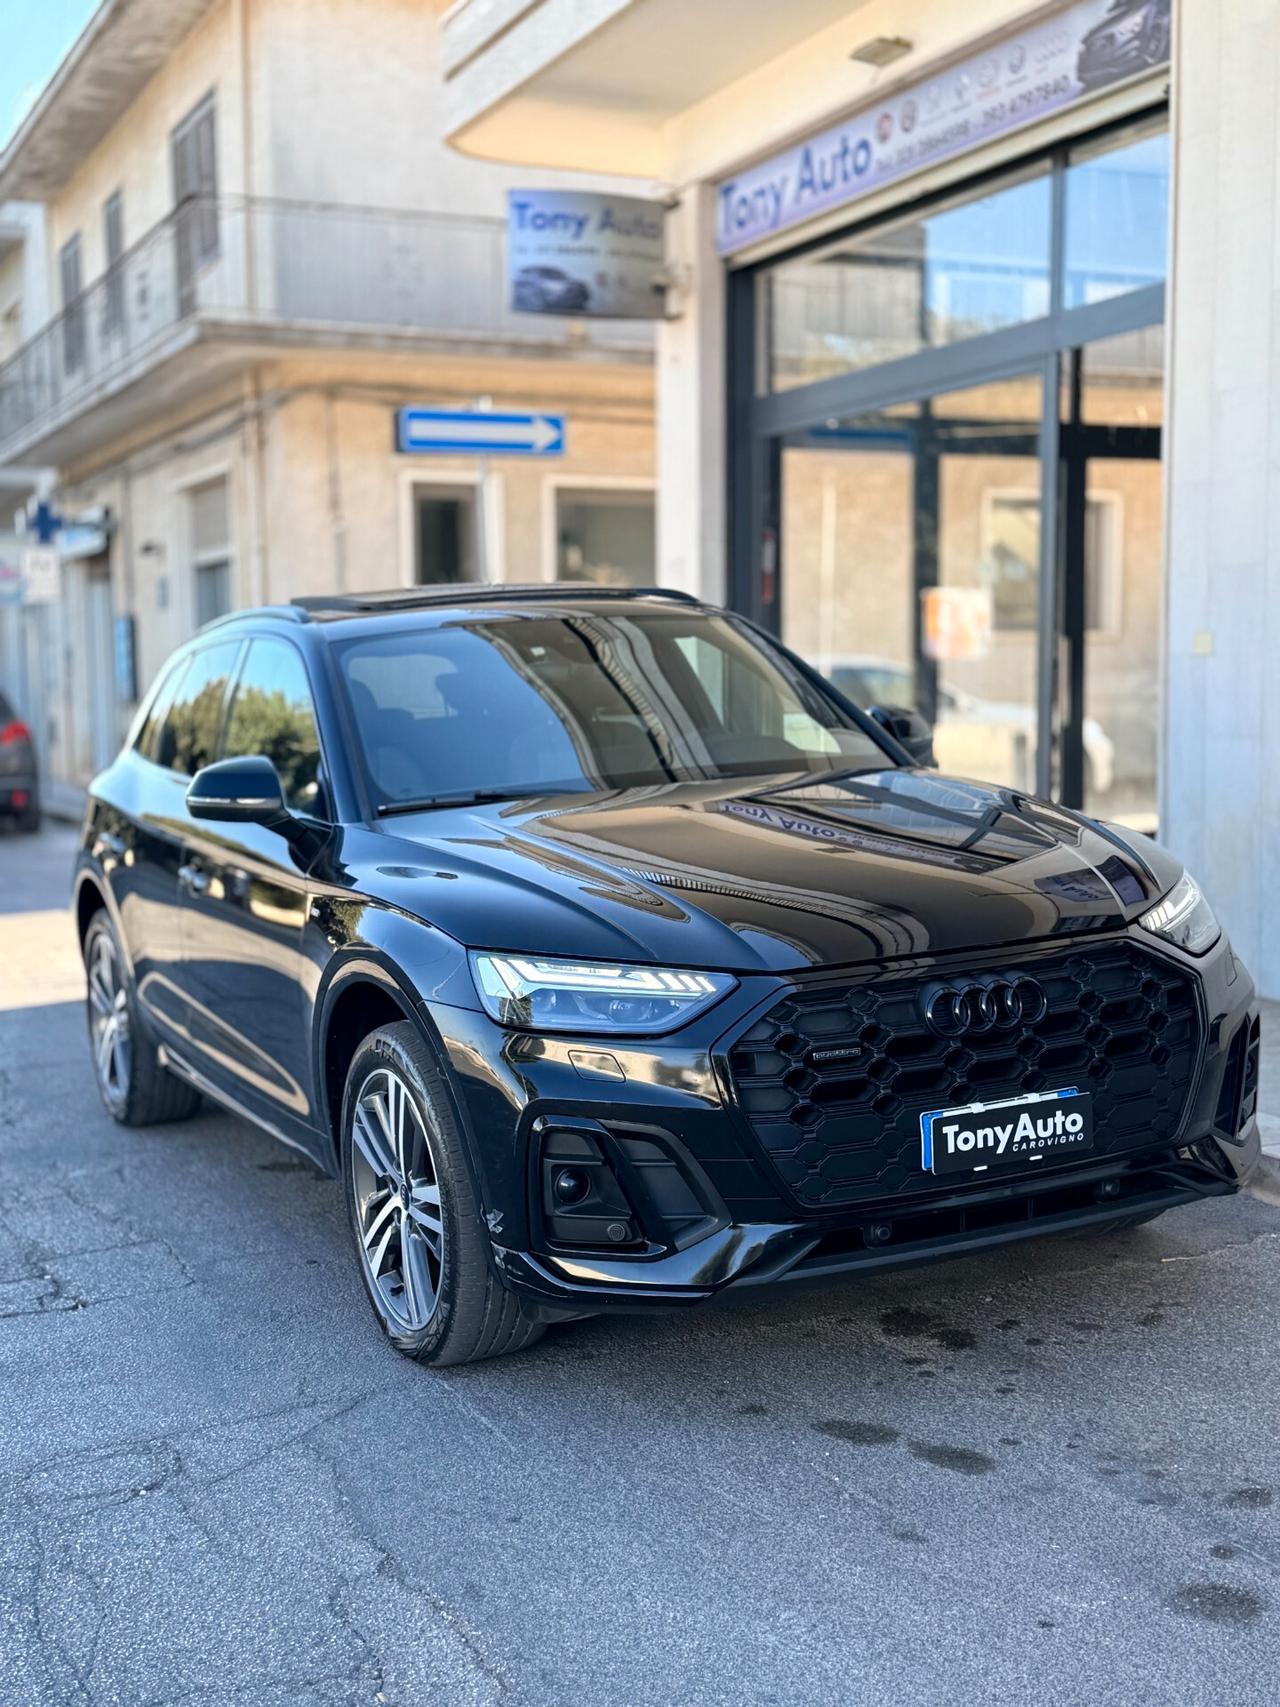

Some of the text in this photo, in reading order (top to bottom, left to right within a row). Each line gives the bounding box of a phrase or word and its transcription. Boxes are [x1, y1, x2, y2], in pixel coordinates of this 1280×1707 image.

[719, 176, 789, 235] Tony
[793, 135, 871, 204] Auto
[512, 200, 589, 240] Tony
[1012, 1132, 1085, 1152] CAROVIGNO
